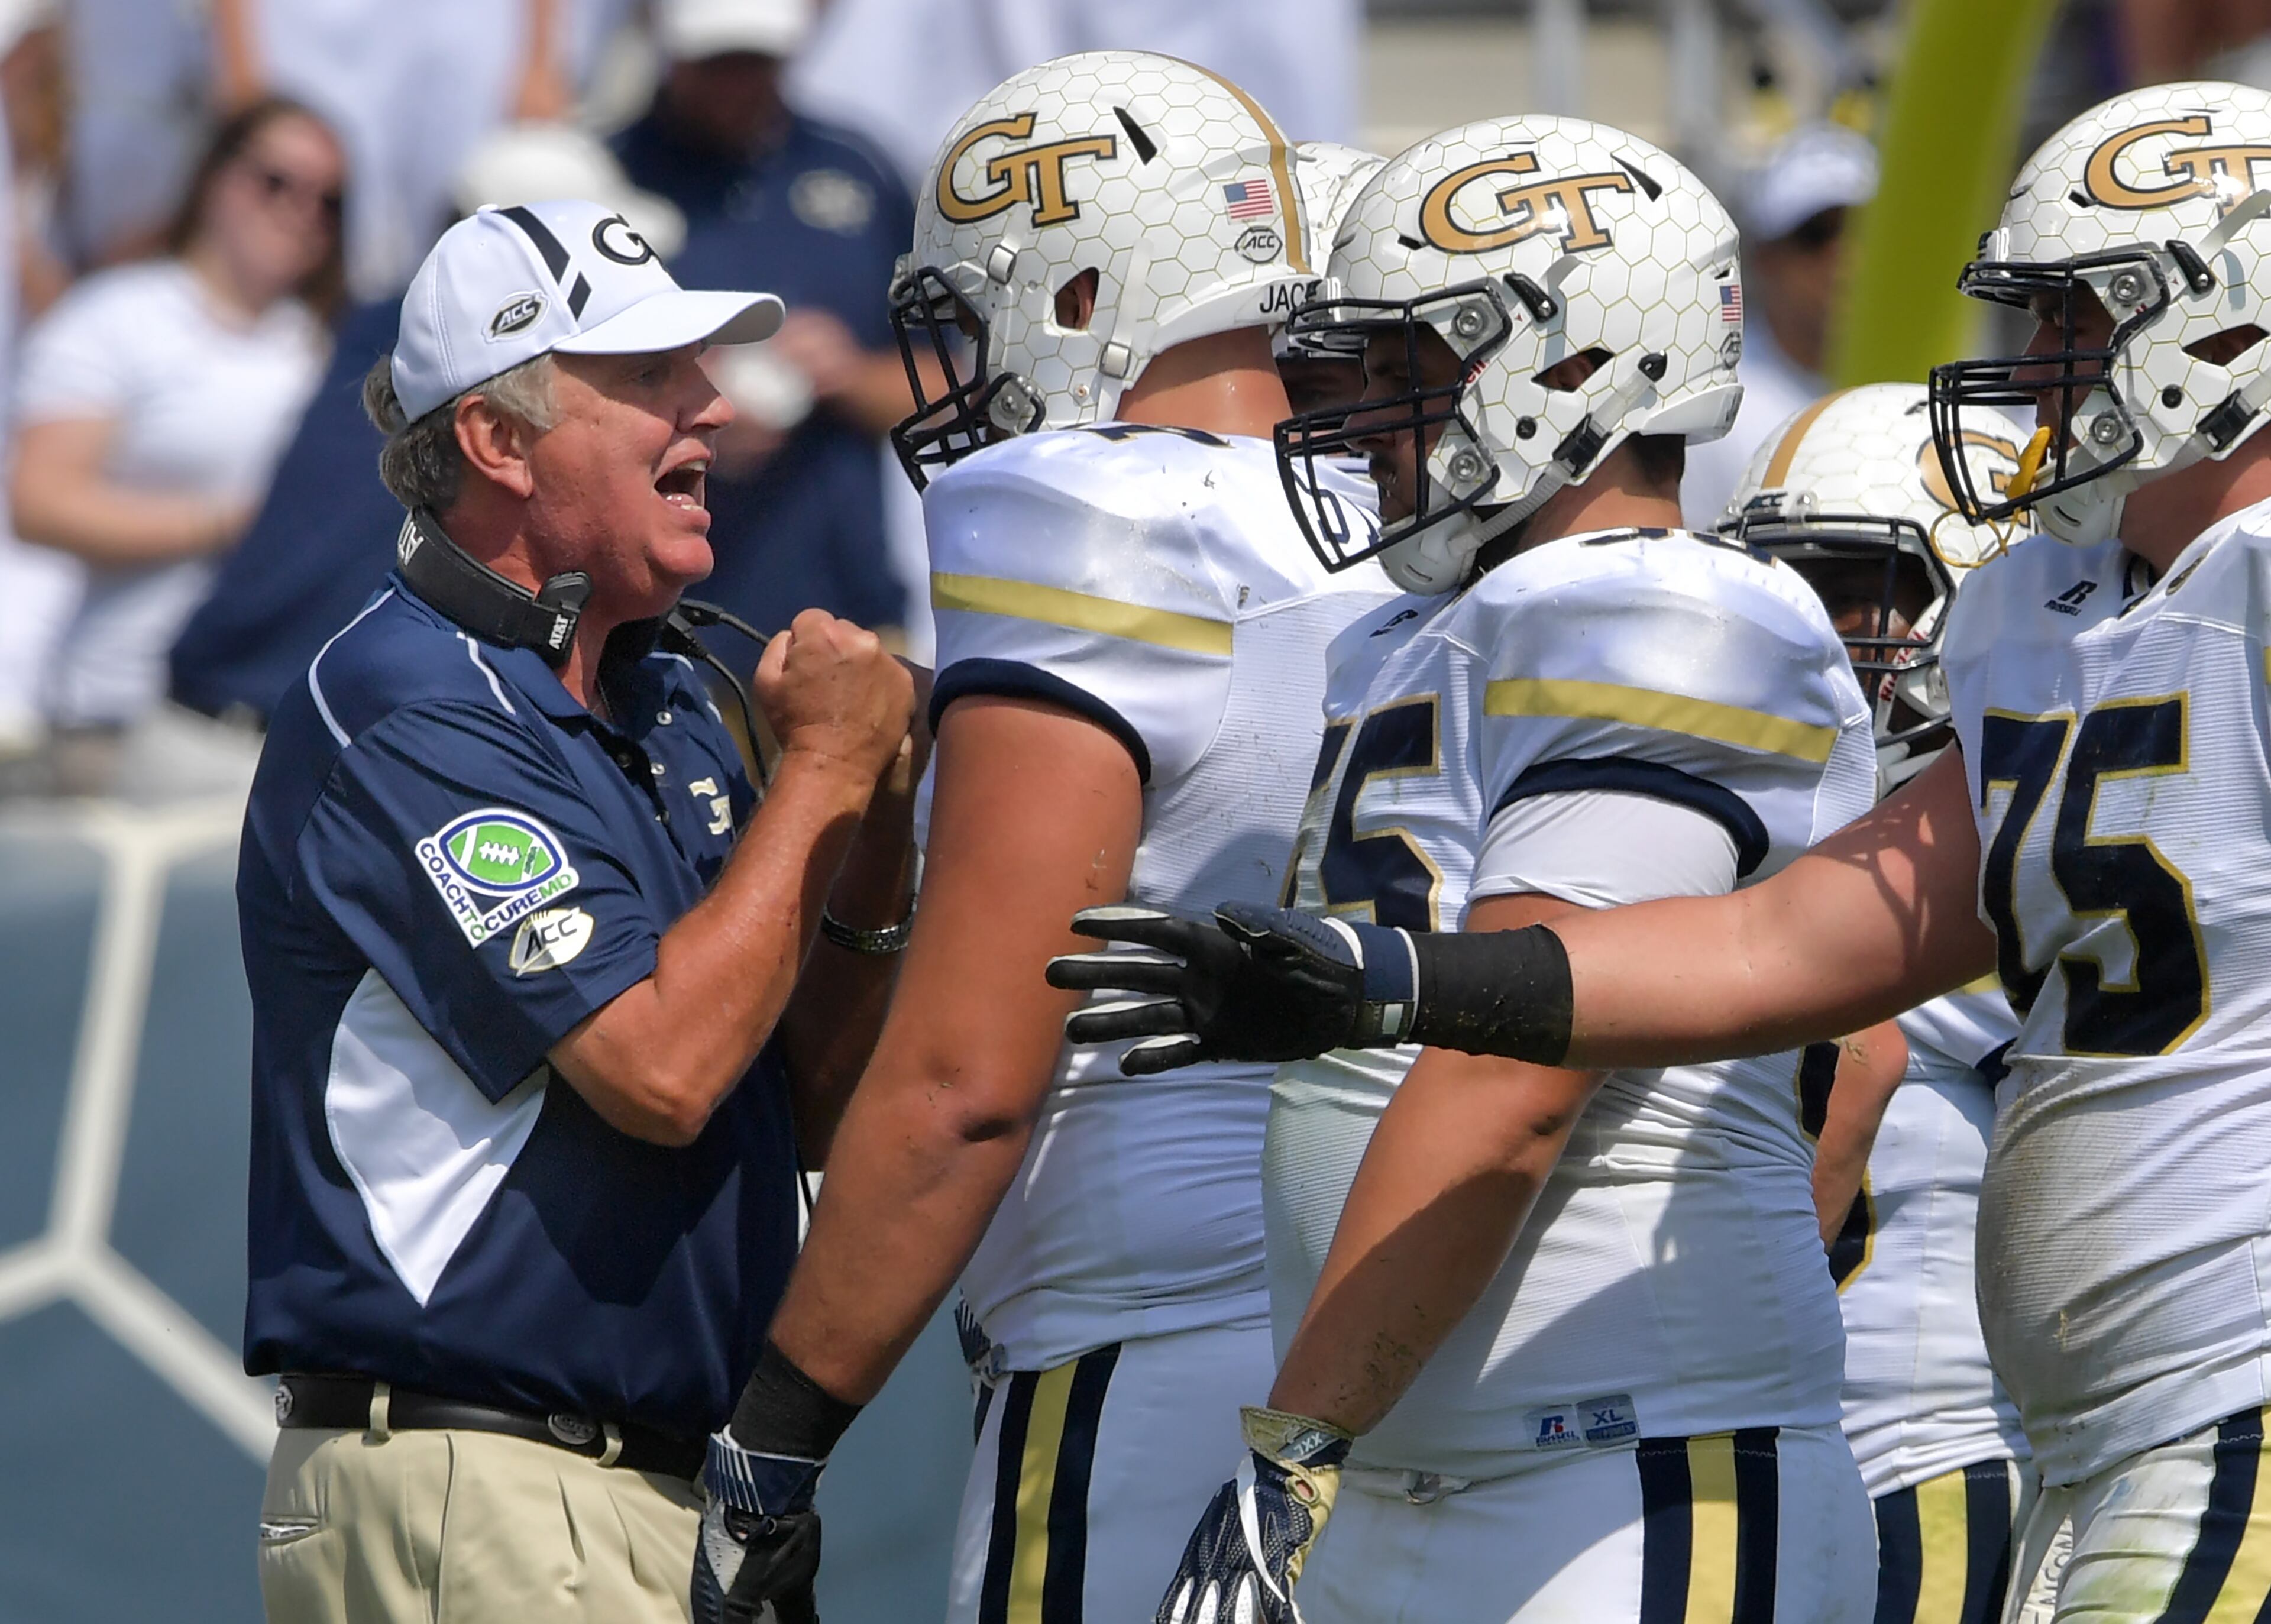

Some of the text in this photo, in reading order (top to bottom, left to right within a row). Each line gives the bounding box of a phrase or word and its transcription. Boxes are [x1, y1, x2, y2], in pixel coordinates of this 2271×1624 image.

[936, 112, 1117, 228] GT
[1419, 151, 1635, 254] GT
[592, 213, 664, 266] G
[1243, 235, 1275, 249] ACC
[494, 300, 535, 336] ACC
[1259, 283, 1306, 313] JAC
[549, 614, 568, 649] AT&T
[1979, 690, 2211, 1057] 75
[523, 914, 578, 963] ACC
[1593, 1409, 1624, 1426] XL
